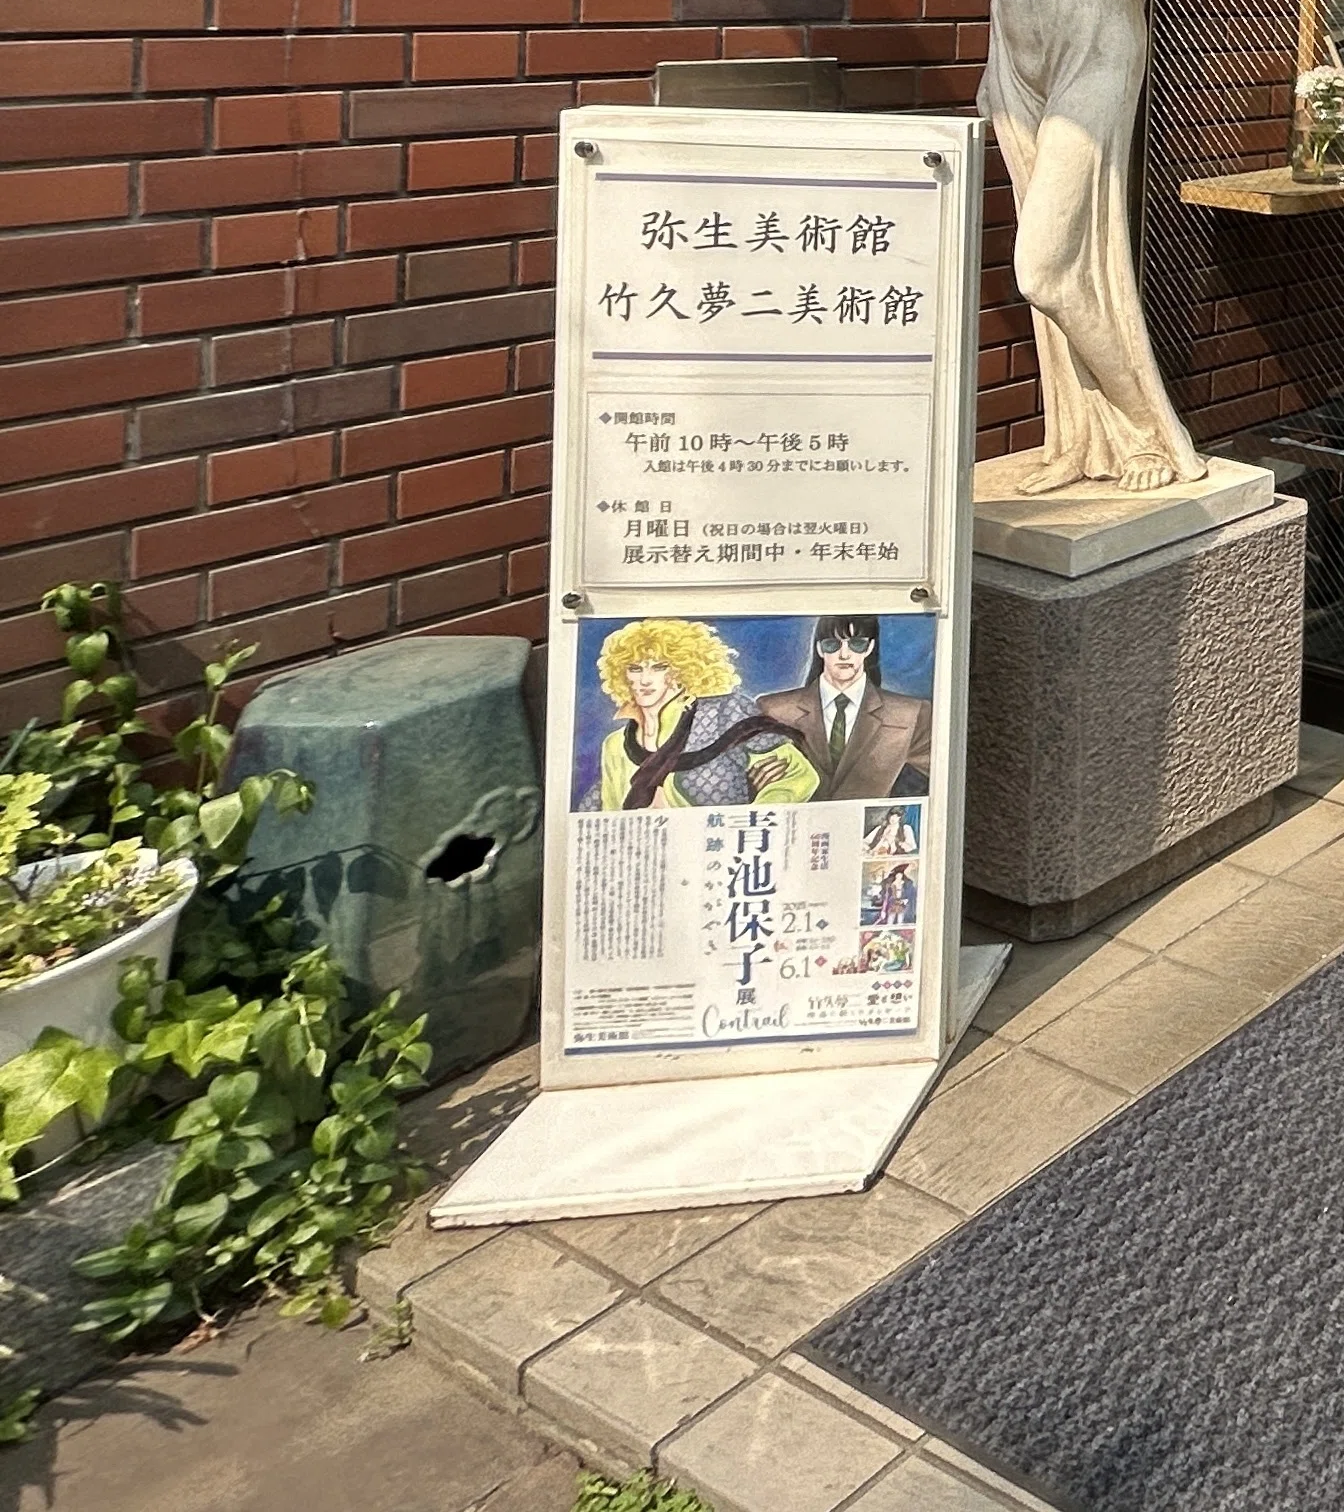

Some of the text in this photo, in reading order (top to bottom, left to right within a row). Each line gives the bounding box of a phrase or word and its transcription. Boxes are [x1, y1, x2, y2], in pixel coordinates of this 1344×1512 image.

[639, 210, 897, 256] 弥生美術館
[598, 281, 925, 328] 竹久夢二美術館
[613, 412, 676, 426] 開館時間
[624, 519, 689, 538] 月曜日
[622, 541, 900, 565] 展示替え期間中・年末年始
[781, 911, 812, 934] 2.1
[779, 956, 812, 980] 6.1
[701, 1003, 790, 1037] Contrail
